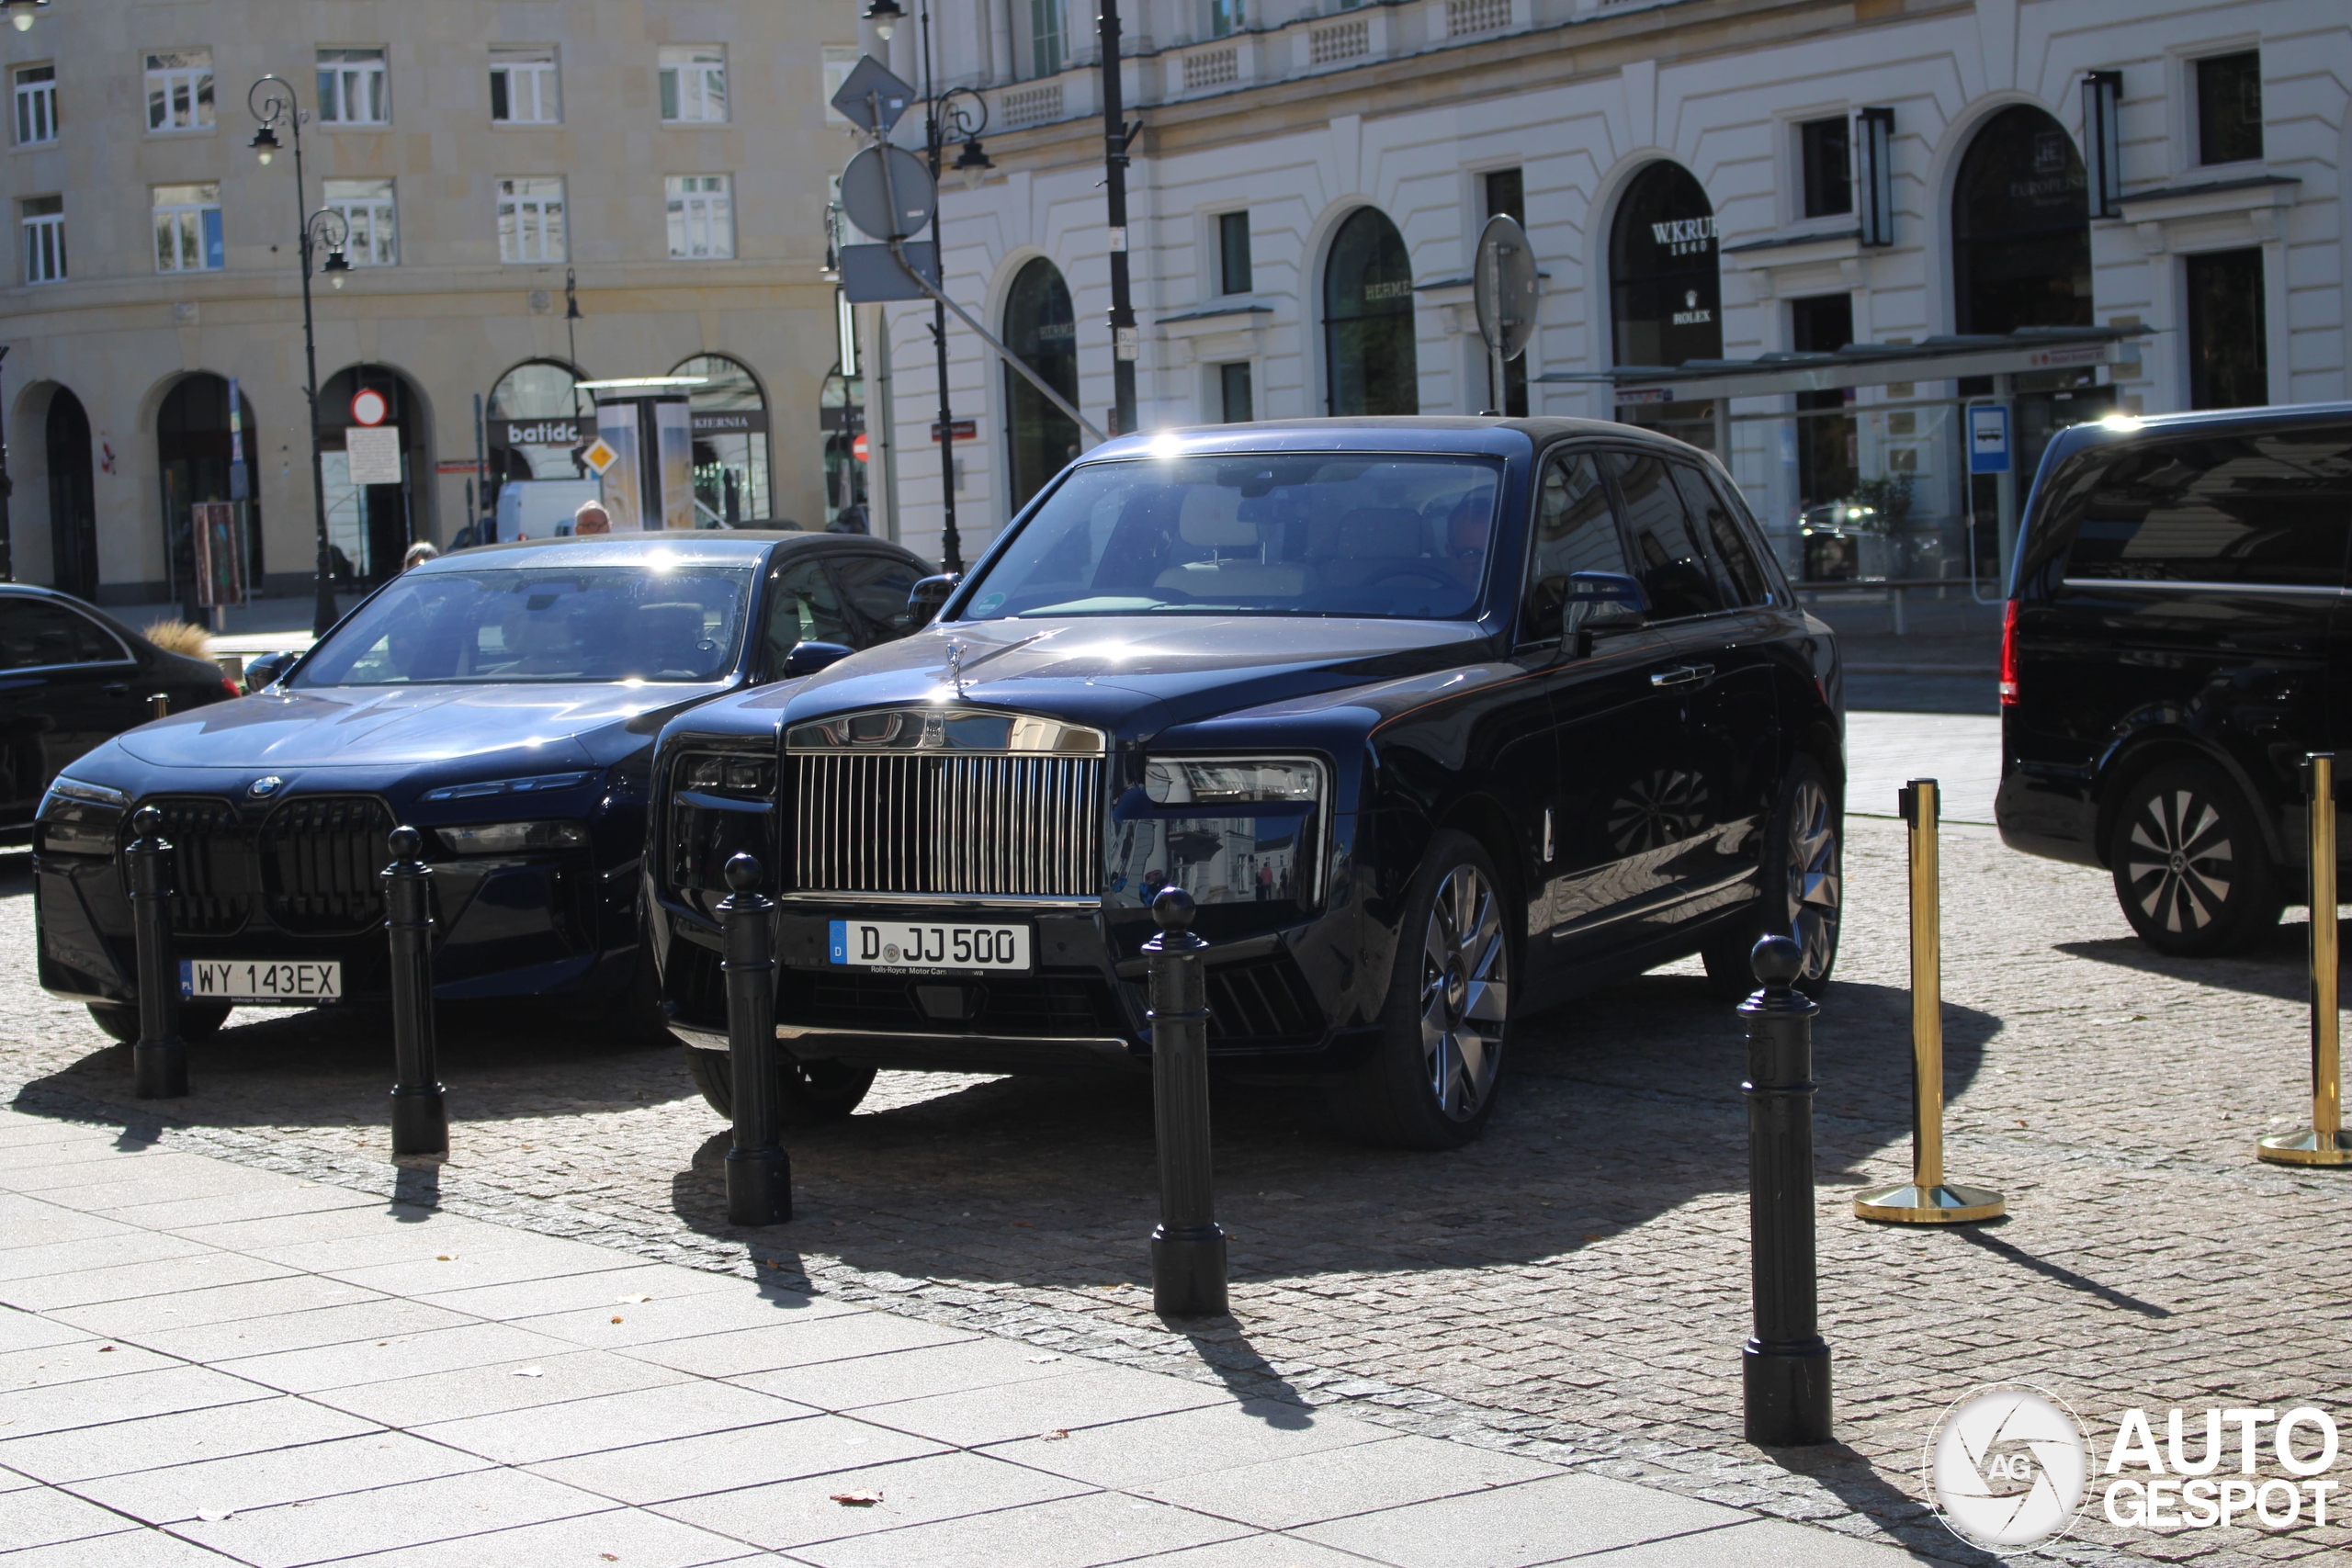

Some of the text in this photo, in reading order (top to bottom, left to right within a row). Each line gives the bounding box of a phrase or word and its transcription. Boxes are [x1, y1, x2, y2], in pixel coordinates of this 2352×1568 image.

[1671, 241, 1707, 255] 1840
[1673, 310, 1711, 325] ROLEX
[692, 416, 749, 429] KIERNIA
[860, 926, 1015, 964] D JJ 500
[834, 947, 842, 957] D
[871, 965, 906, 975] Rolls-Royce
[931, 967, 947, 976] Cars
[182, 982, 192, 990] PL
[198, 964, 334, 995] WY 143EX
